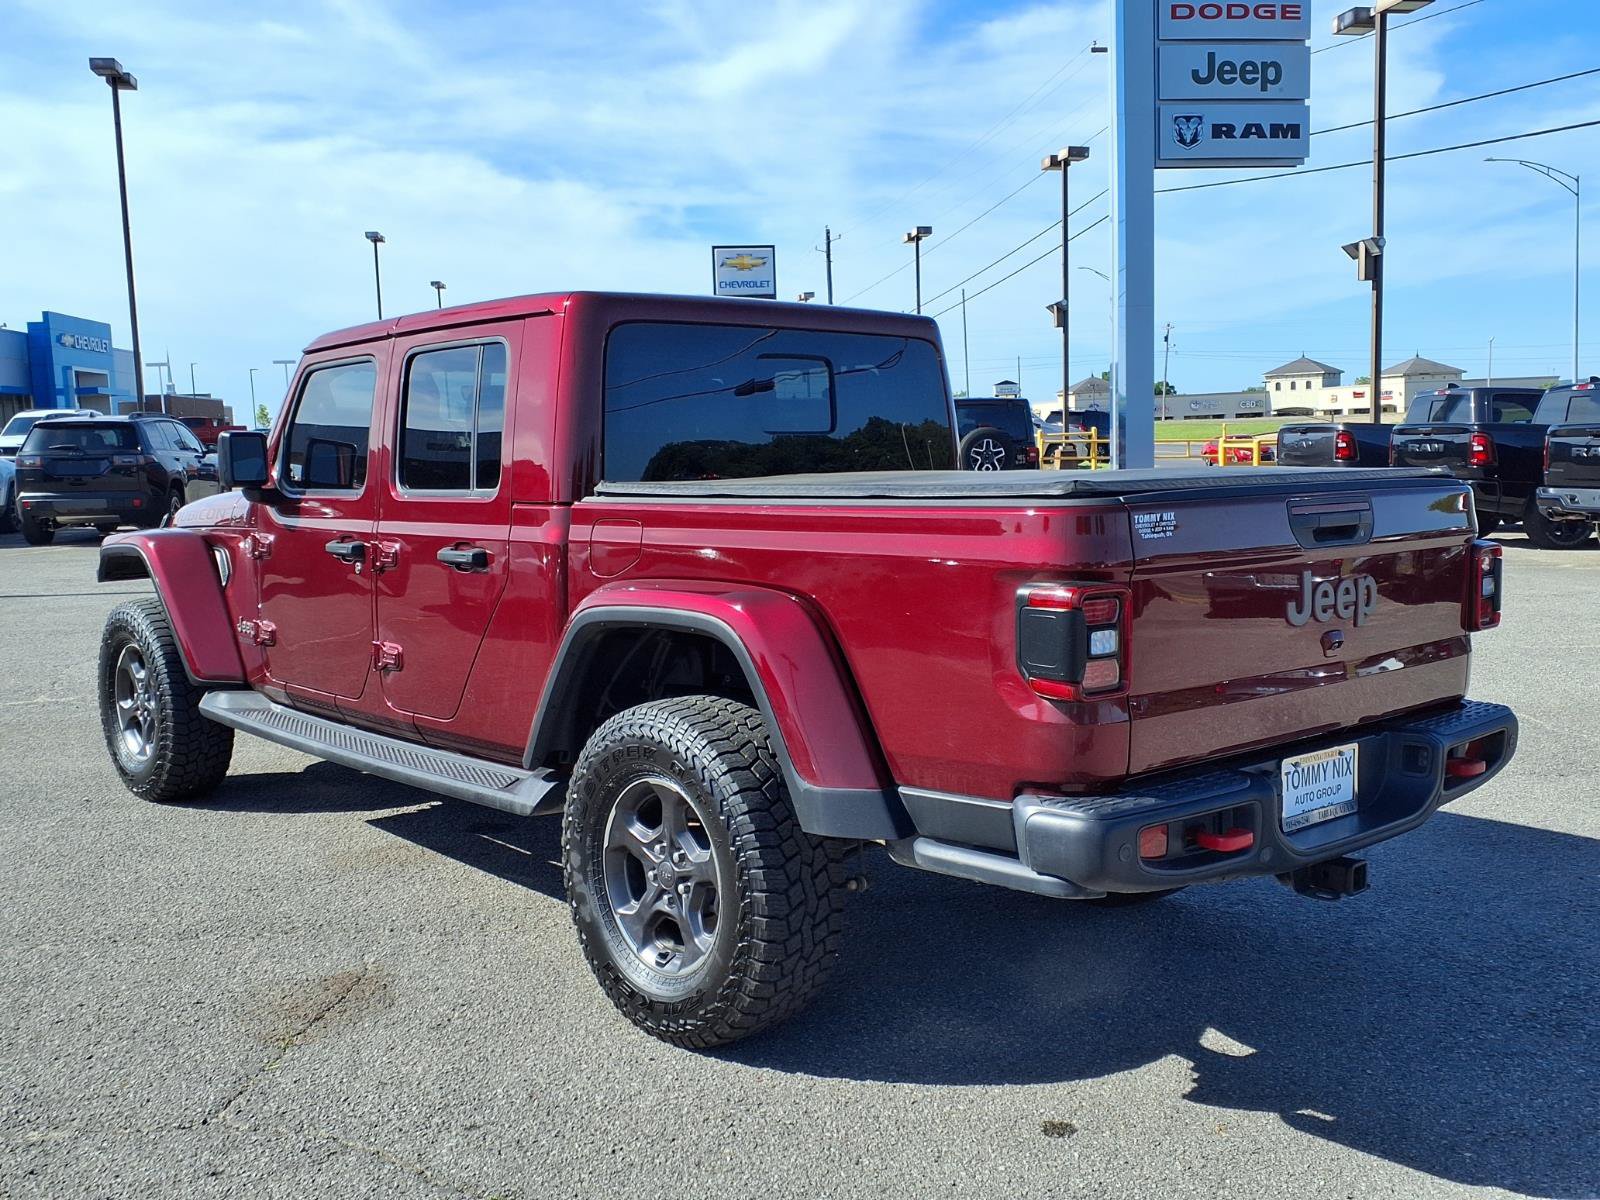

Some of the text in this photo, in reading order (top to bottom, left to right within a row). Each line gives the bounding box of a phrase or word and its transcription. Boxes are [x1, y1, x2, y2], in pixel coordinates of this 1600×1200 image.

[1171, 4, 1302, 20] DODGE
[1192, 52, 1283, 92] Jeep
[1211, 123, 1301, 139] RAM
[719, 280, 771, 289] CHEVROLET
[75, 334, 110, 353] CHEVROLET
[1408, 443, 1445, 452] RAM
[1134, 512, 1175, 523] TOMMY NIX
[1286, 570, 1377, 627] Jeep
[1284, 761, 1330, 792] TOMMY
[1333, 756, 1353, 779] NIX
[1294, 784, 1342, 806] AUTO GROUP
